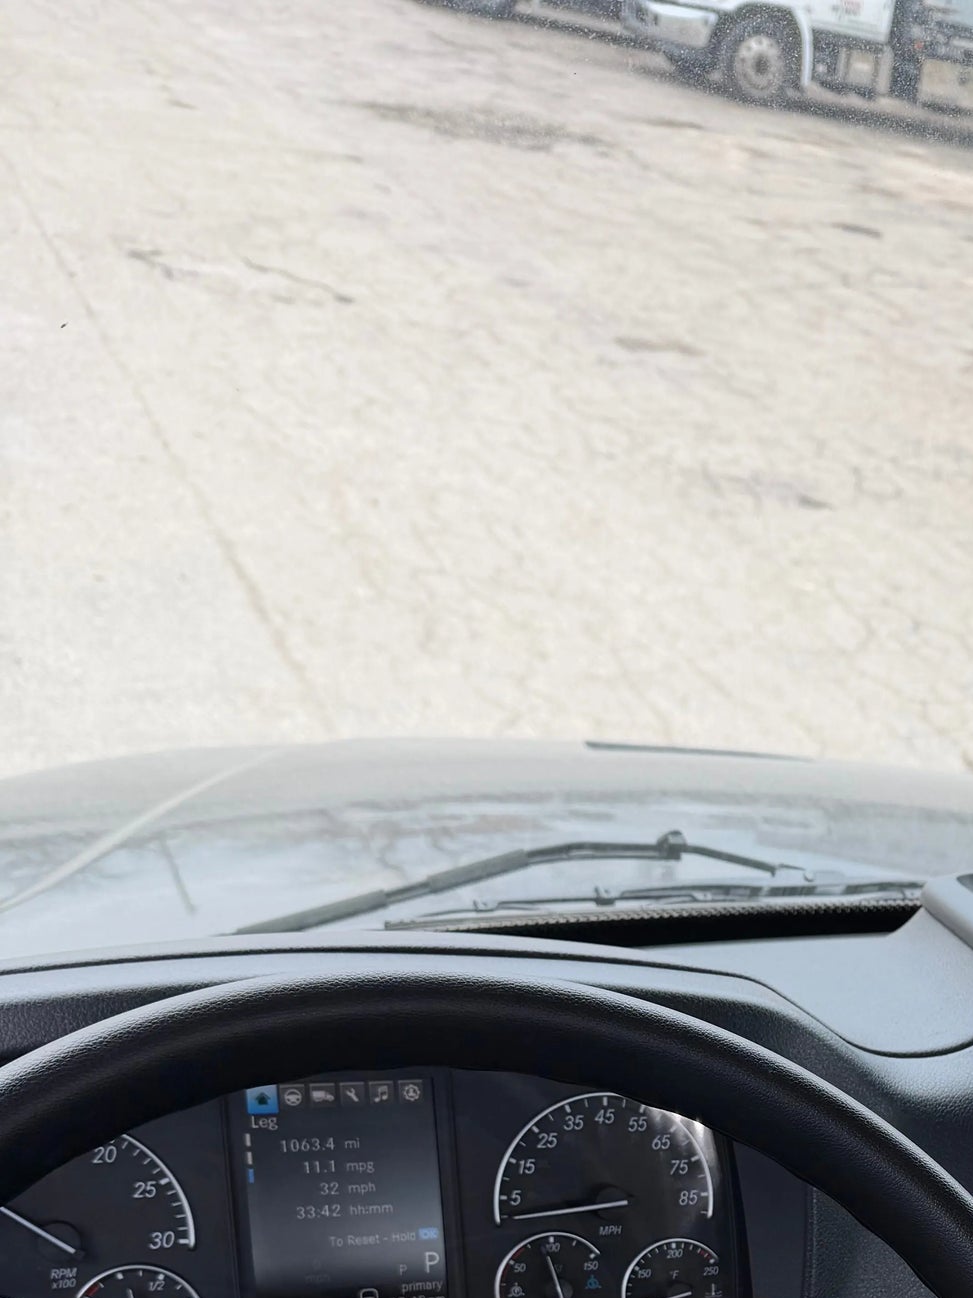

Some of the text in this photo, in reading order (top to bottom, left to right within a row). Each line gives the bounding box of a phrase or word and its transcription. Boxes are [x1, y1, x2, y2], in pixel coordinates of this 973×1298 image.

[251, 1115, 278, 1130] Leg
[563, 1115, 584, 1131] 35
[594, 1109, 615, 1124] 45
[628, 1116, 648, 1132] 55
[281, 1137, 360, 1153] 1063.4 mi
[537, 1133, 558, 1149] 25
[652, 1135, 671, 1150] 65
[92, 1146, 117, 1164] 20
[304, 1160, 375, 1174] 11.1 mpg
[518, 1159, 536, 1174] 15
[670, 1160, 689, 1175] 75
[133, 1181, 157, 1199] 25
[320, 1182, 376, 1195] 32 mph
[510, 1190, 522, 1205] 5
[679, 1190, 698, 1205] 85
[296, 1204, 342, 1219] 33:42
[599, 1226, 622, 1236] MPH
[149, 1231, 175, 1249] 30
[329, 1236, 343, 1247] To
[347, 1234, 380, 1246] Reset
[666, 1249, 683, 1259] 200
[425, 1252, 440, 1273] P
[514, 1262, 526, 1273] 50
[584, 1261, 598, 1271] 150
[51, 1268, 77, 1279] RPM
[638, 1268, 652, 1278] 150
[703, 1266, 719, 1276] 250
[51, 1278, 76, 1289] x100
[402, 1281, 443, 1294] primary
